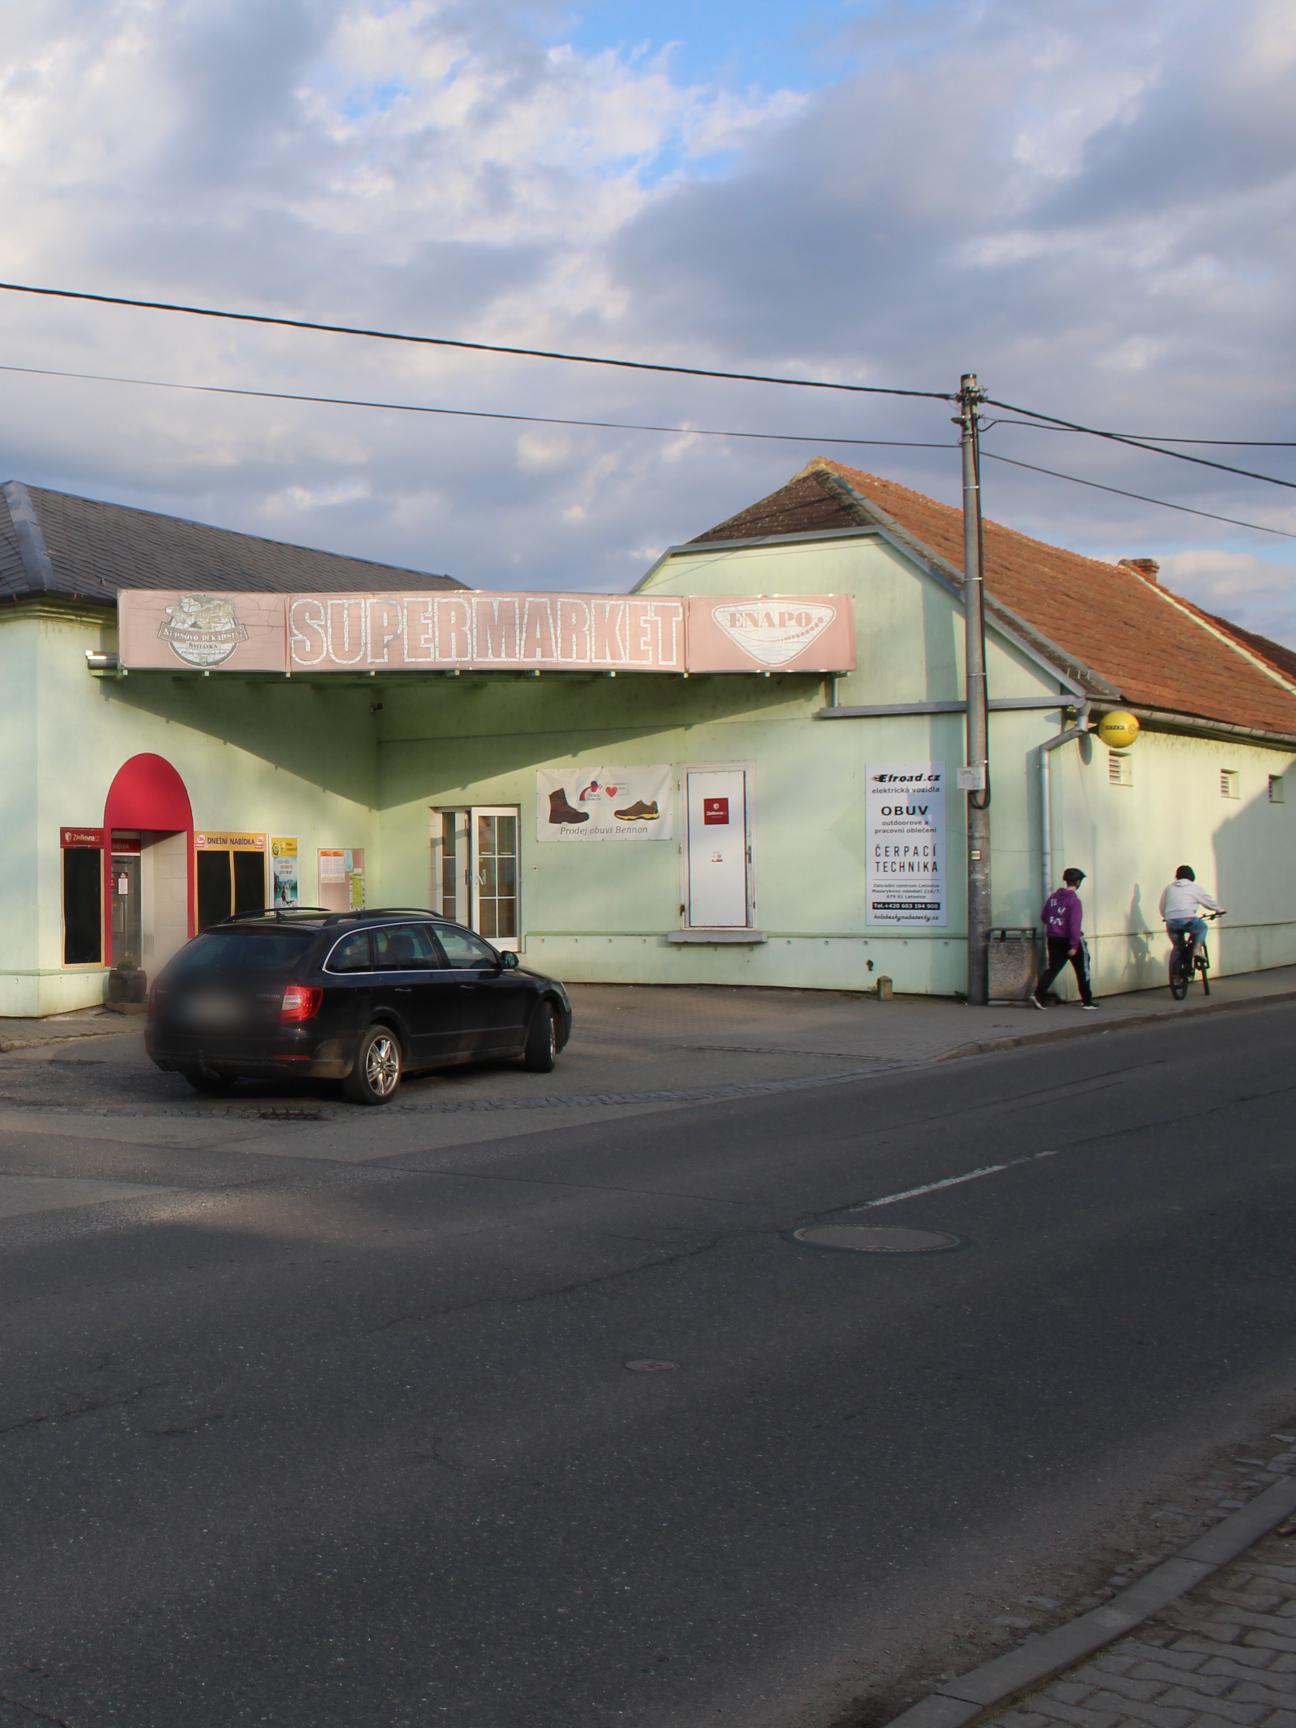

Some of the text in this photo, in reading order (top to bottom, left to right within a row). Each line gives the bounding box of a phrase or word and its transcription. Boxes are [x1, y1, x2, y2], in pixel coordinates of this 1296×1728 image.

[728, 610, 814, 629] ENAPO
[290, 597, 683, 666] SUPERMARKET
[872, 786, 910, 794] elektrická
[881, 805, 929, 816] OBUV
[559, 825, 649, 837] Prodej obuvi Bennon
[874, 826, 937, 835] pracovní oblečení
[207, 836, 228, 844] DNEŠNÍ
[229, 836, 255, 846] NABÍDKA
[875, 844, 936, 857] ČERPACÍ
[875, 861, 938, 872] TECHNIKA
